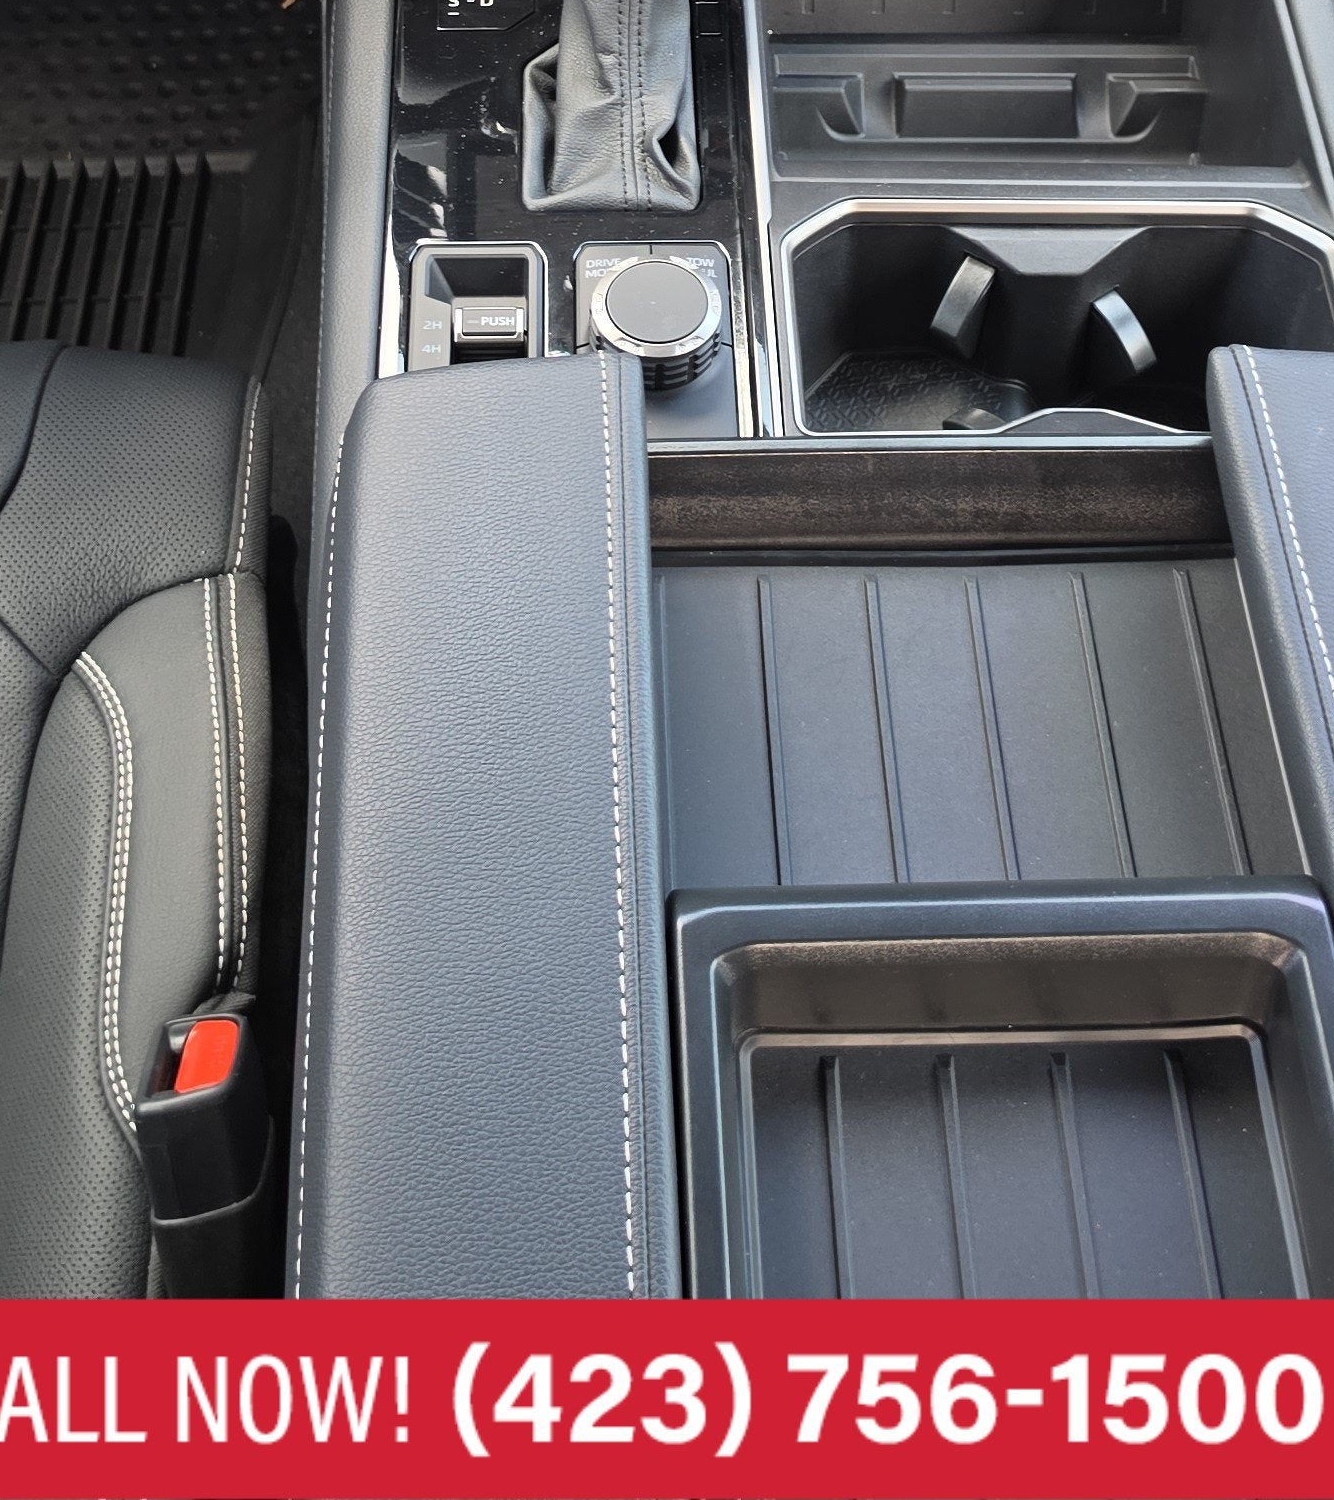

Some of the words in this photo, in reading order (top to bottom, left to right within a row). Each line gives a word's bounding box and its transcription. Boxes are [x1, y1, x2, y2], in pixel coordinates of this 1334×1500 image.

[422, 321, 443, 330] 2H
[480, 316, 516, 326] PUSH
[421, 344, 442, 353] 4H
